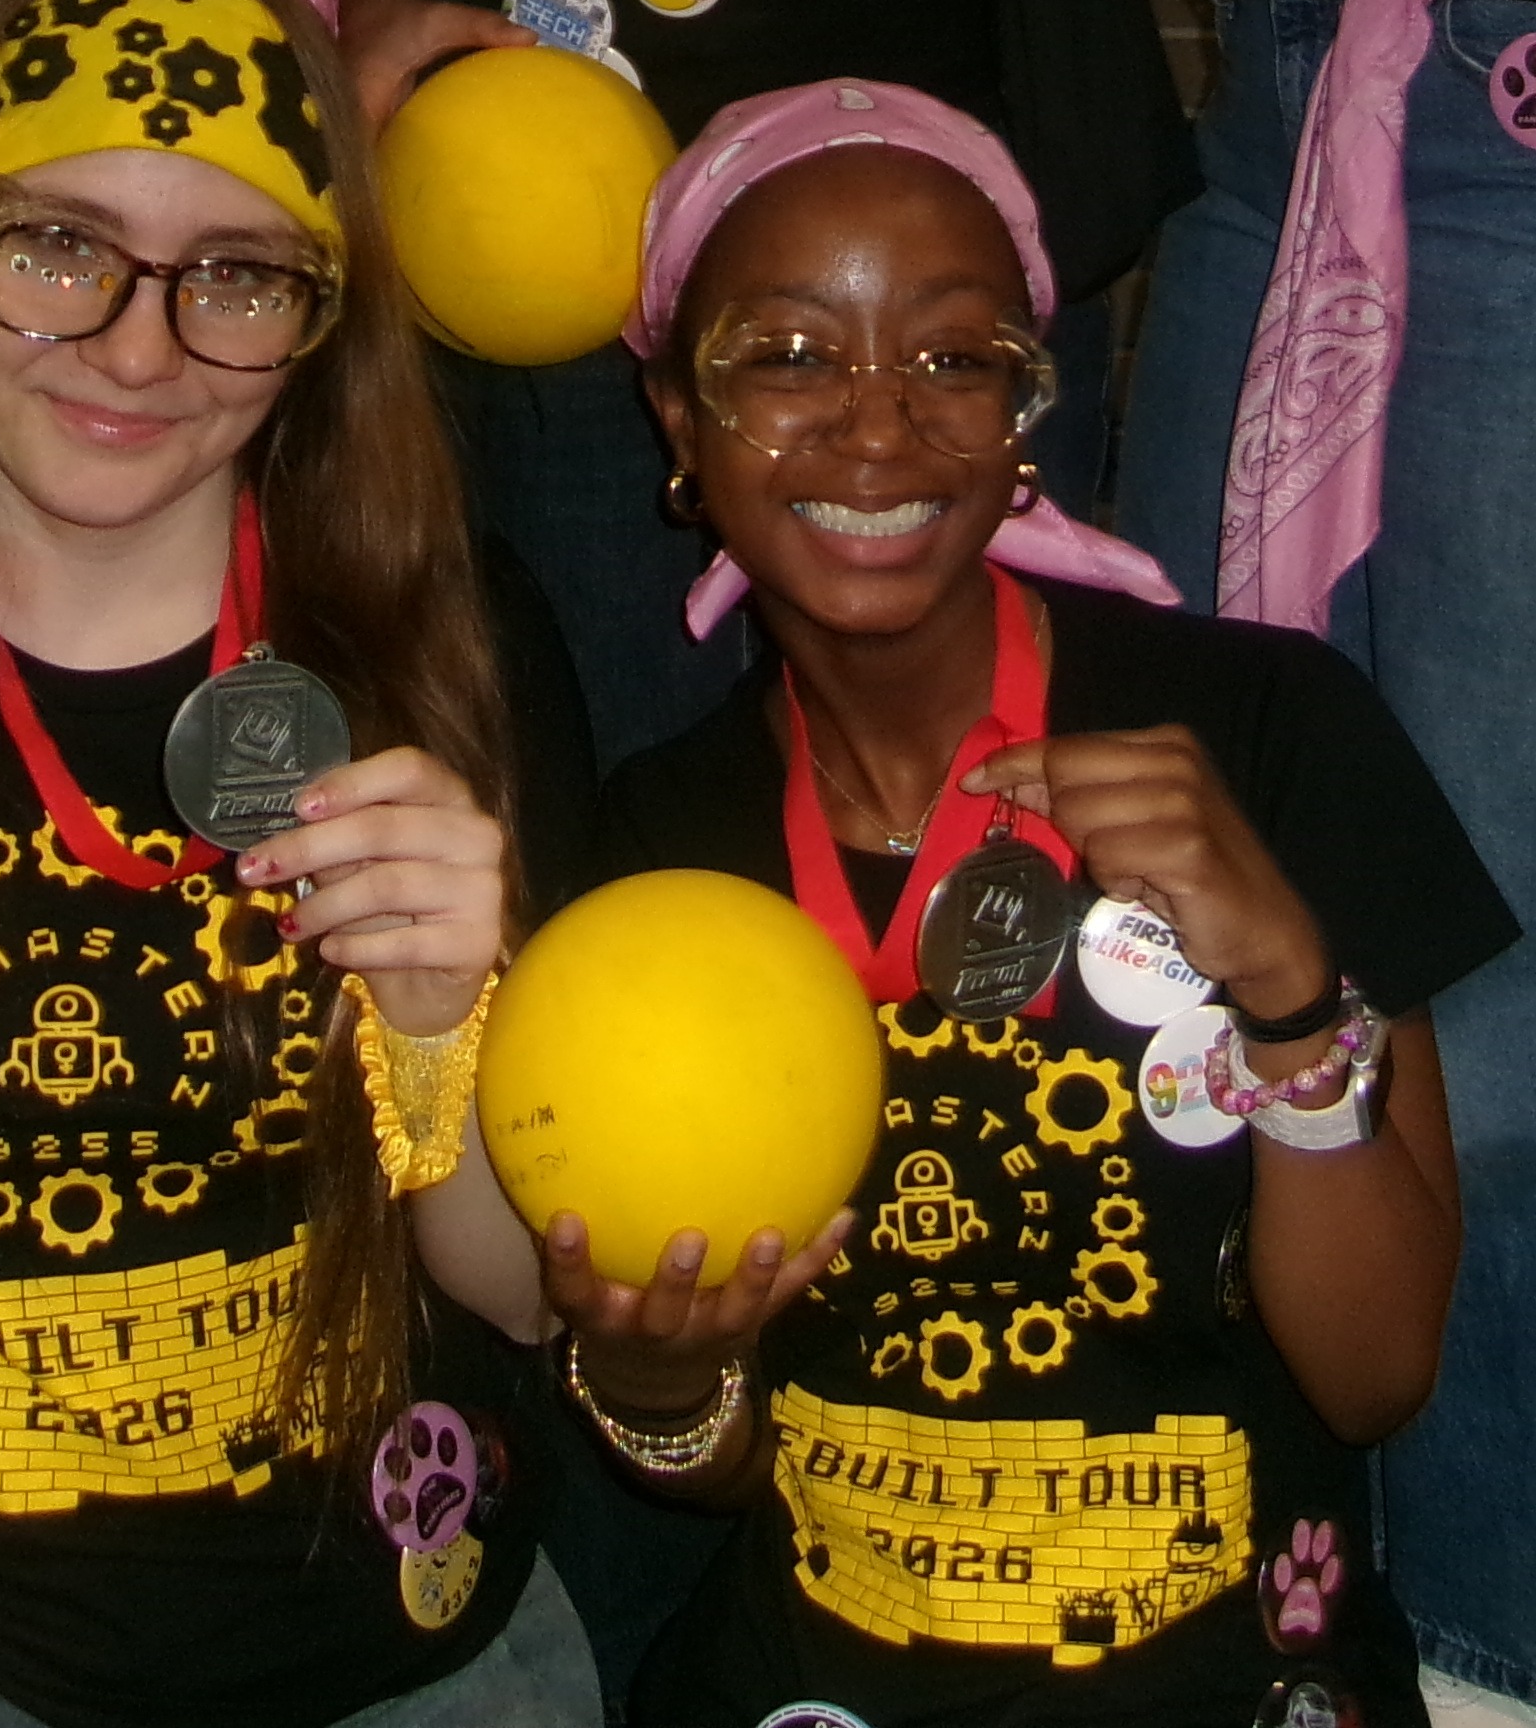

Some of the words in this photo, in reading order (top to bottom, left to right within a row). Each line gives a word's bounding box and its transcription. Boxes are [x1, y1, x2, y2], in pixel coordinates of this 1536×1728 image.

[773, 1421, 1003, 1508] EBUILT
[1034, 1462, 1206, 1513] TOUR
[866, 1527, 1033, 1583] 2026
